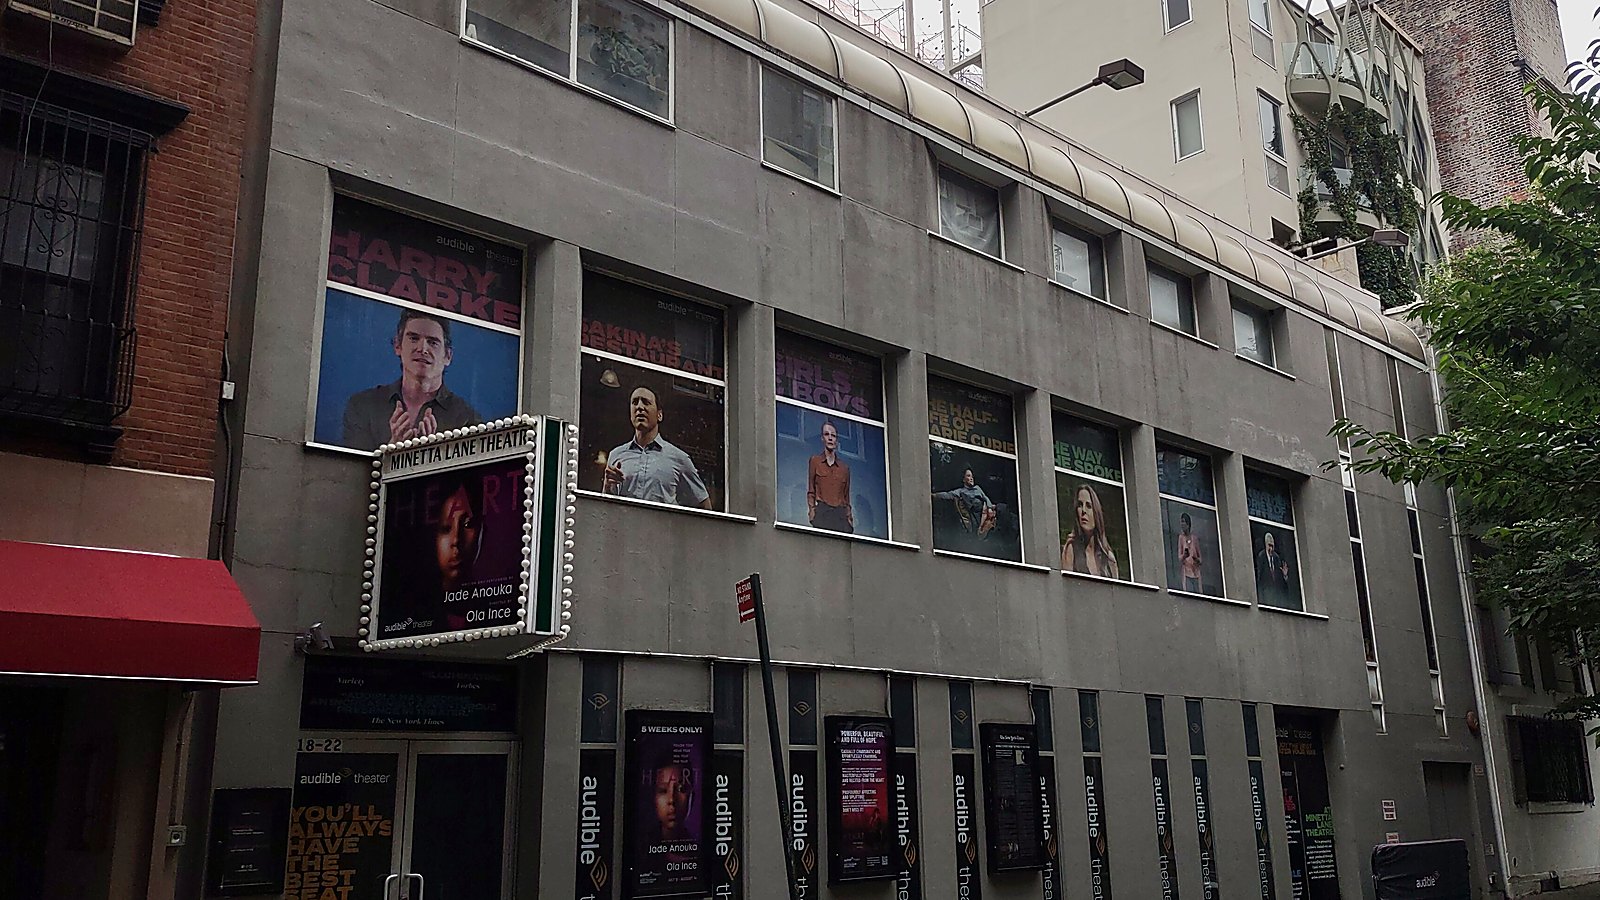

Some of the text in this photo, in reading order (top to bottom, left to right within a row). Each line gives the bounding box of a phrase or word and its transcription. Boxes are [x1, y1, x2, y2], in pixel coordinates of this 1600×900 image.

[436, 235, 475, 253] audible
[330, 230, 498, 294] HARRY
[327, 254, 521, 329] CLARKE
[657, 300, 687, 315] audible
[792, 381, 870, 417] BOYS
[953, 416, 975, 432] OF
[970, 433, 1016, 454] CURIE
[390, 446, 442, 470] MINETTA
[444, 438, 477, 461] LANE
[1071, 445, 1103, 464] WAY
[1073, 460, 1121, 481] SPOKE
[394, 468, 525, 527] HEART
[443, 583, 513, 603] Jade Anouka
[466, 607, 512, 623] Ola Ince
[384, 622, 407, 632] audible
[371, 717, 385, 725] The
[423, 717, 445, 725] Times
[648, 725, 678, 733] WEEKS
[678, 726, 703, 734] ONLY!
[297, 738, 342, 752] 18-22
[300, 772, 391, 785] audible theater
[291, 803, 383, 823] YOU'LL
[792, 773, 810, 851] audible
[955, 774, 970, 844] audible
[1086, 775, 1099, 838] audible
[1153, 776, 1166, 836] audible
[1194, 775, 1208, 833] audible
[580, 775, 601, 865] audible
[715, 774, 732, 857] audible
[290, 819, 393, 839] ALWAYS
[1250, 776, 1270, 898] audible theater
[288, 836, 360, 855] HAVE
[648, 843, 698, 854] Jade Anouka
[287, 854, 340, 873] THE
[666, 861, 698, 871] Ola Ince
[286, 869, 356, 889] BEST
[1415, 876, 1436, 888] audible
